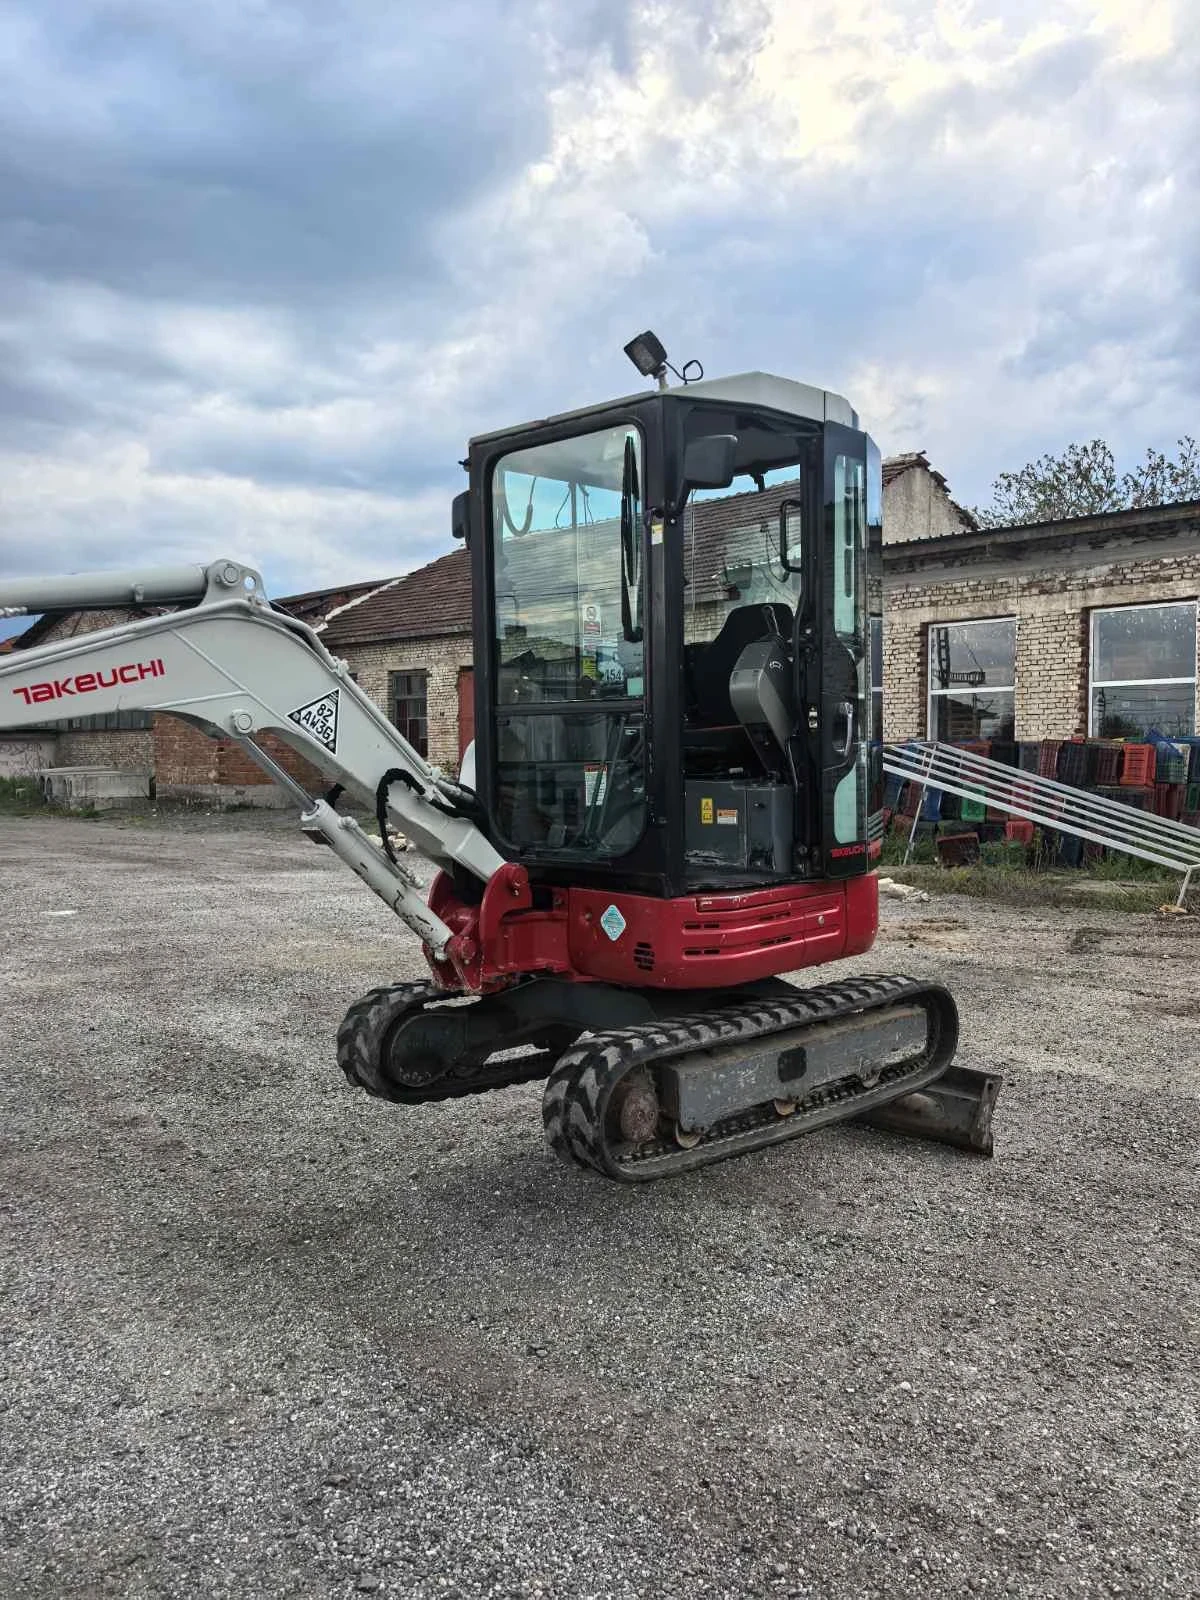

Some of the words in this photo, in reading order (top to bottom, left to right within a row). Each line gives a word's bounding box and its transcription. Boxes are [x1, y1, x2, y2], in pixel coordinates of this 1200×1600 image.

[13, 659, 165, 704] TAKEUCHI
[302, 710, 333, 740] AW3G
[317, 703, 334, 723] 82
